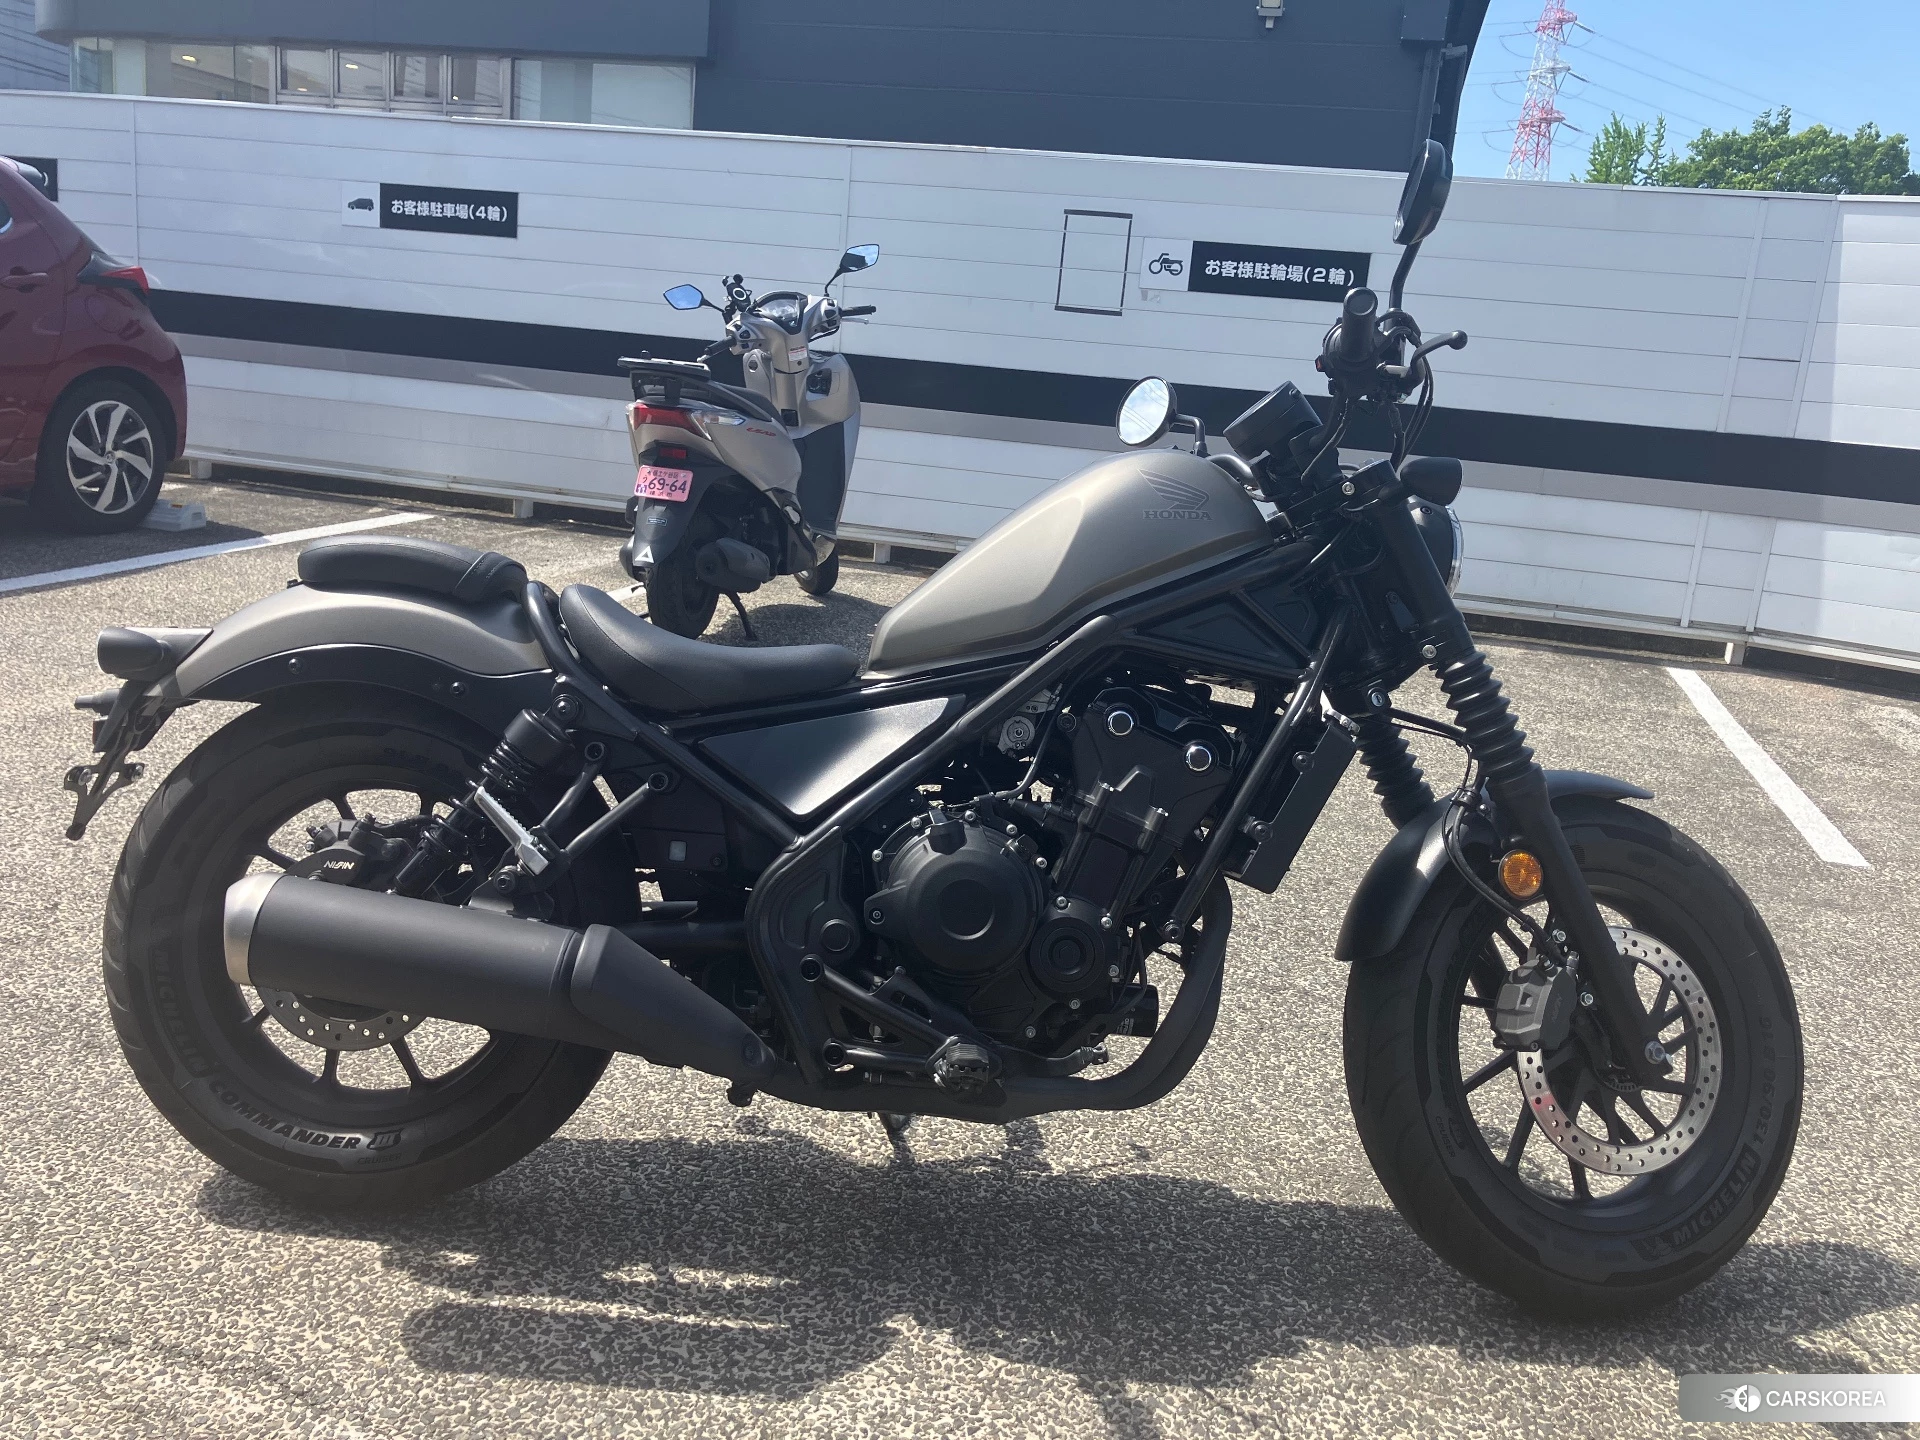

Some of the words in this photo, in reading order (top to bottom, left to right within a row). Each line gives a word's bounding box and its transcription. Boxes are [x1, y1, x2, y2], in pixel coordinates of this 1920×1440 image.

[390, 199, 508, 222] お客様駐車場(4輪)
[1204, 259, 1355, 286] お客様駐輪場(2輪)
[648, 477, 687, 494] 69-64
[1143, 509, 1214, 521] HONDA
[208, 1080, 362, 1151] COMMANDER
[1673, 1151, 1758, 1246] MICHELIN
